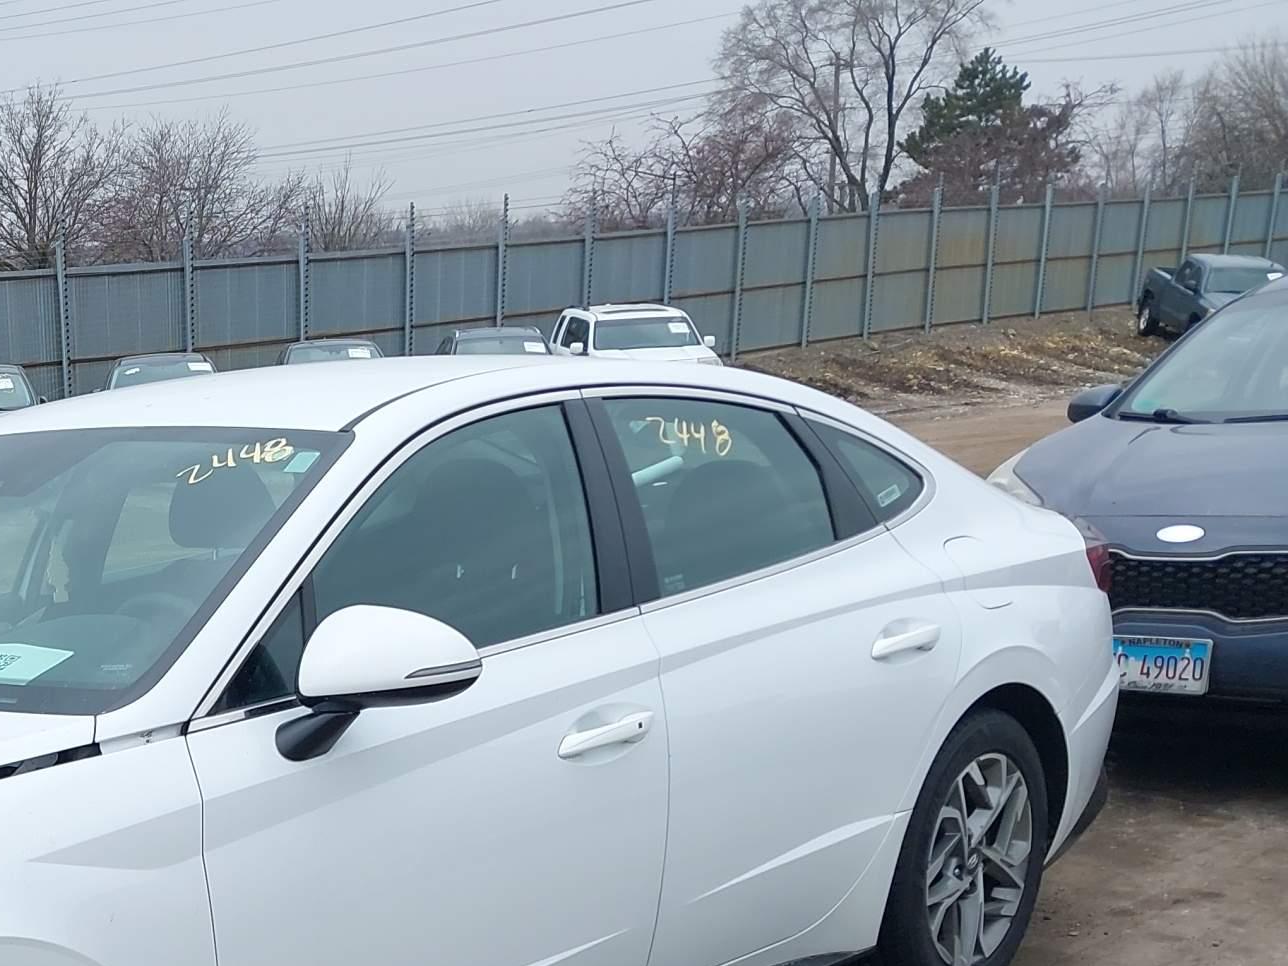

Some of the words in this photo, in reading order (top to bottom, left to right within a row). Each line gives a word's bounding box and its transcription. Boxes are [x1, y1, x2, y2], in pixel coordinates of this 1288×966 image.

[644, 416, 732, 456] 2448
[175, 437, 295, 485] 2448
[1140, 654, 1205, 681] 49020
